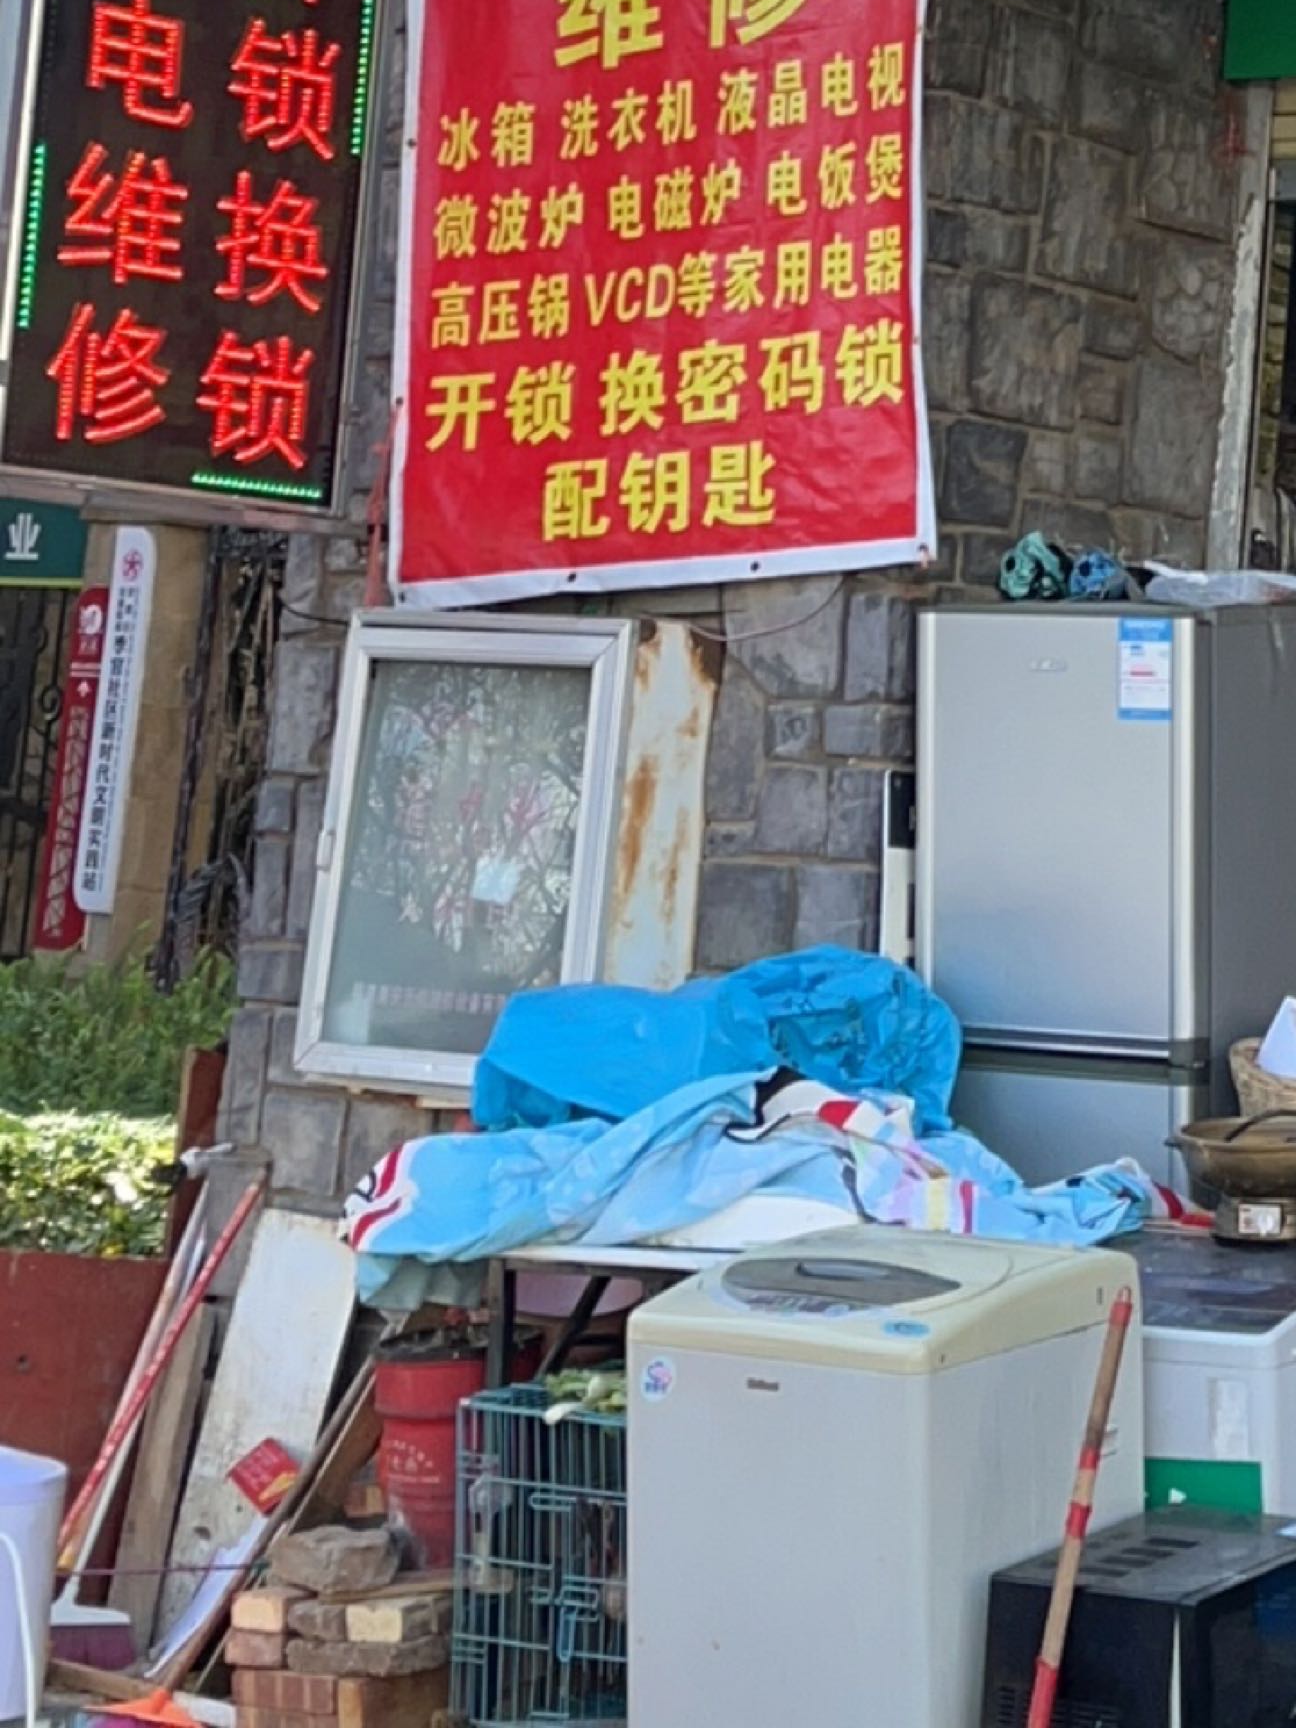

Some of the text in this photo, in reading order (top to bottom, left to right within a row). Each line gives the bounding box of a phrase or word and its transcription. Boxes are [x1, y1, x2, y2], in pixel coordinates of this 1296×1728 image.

[438, 42, 906, 171] 冰箱 洗衣机 液晶电视
[433, 133, 904, 260] 微波炉 电磁炉 电饭煲
[431, 227, 904, 349] 高压锅 VCD等家用电器
[426, 318, 904, 452] 开锁 换密码锁
[541, 440, 777, 541] 配钥匙
